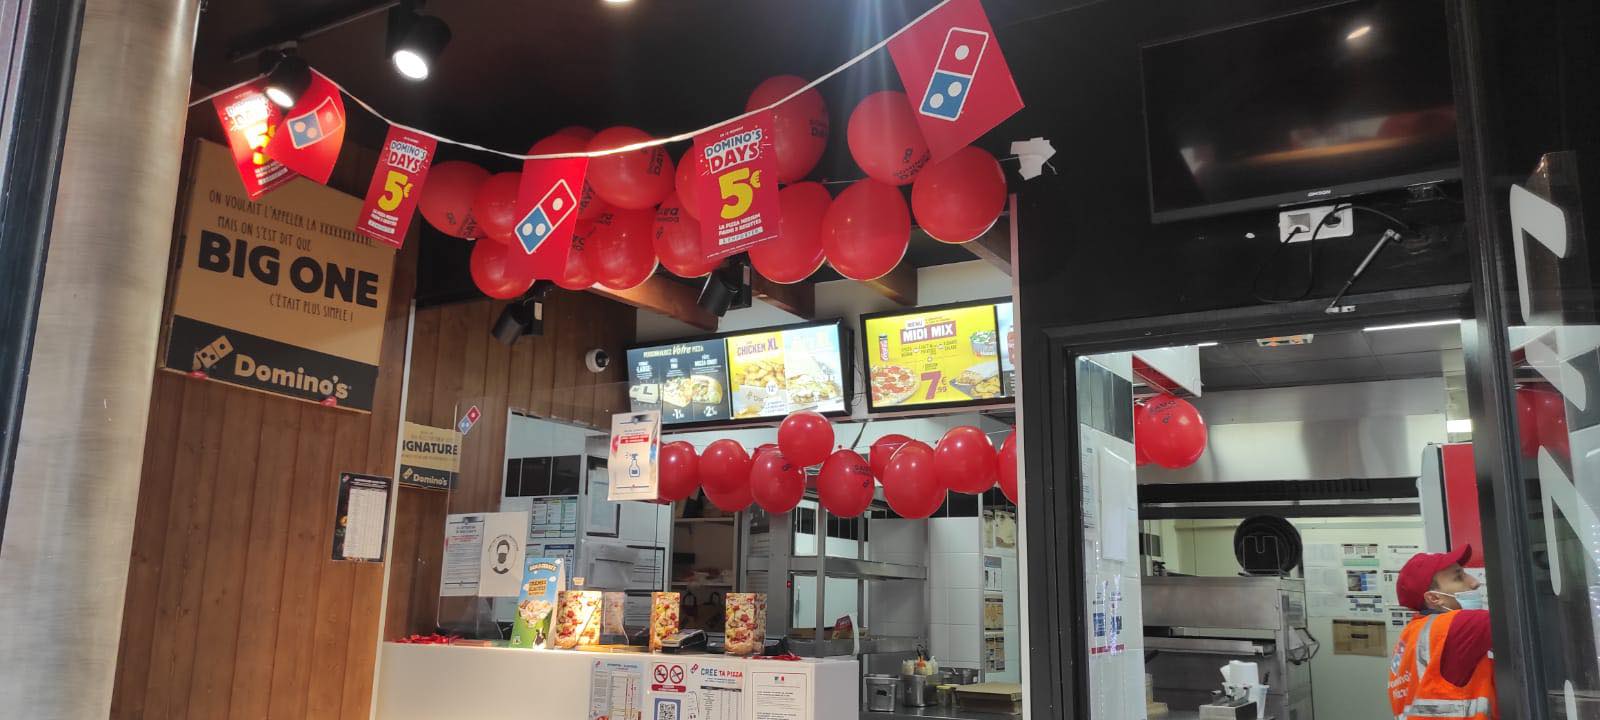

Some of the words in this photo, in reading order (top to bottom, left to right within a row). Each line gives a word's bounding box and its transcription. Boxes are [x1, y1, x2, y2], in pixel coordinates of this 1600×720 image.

[391, 141, 427, 160] DOMINO'S
[706, 129, 762, 158] DOMINO'S
[389, 151, 421, 173] DAYS
[711, 142, 759, 171] DAYS
[208, 189, 221, 203] ON
[225, 194, 262, 216] VOULAIT
[263, 203, 304, 229] L'APPELER
[306, 217, 318, 233] LA
[217, 215, 238, 234] MAIS
[241, 222, 253, 237] ON
[255, 224, 277, 242] S'EST
[279, 231, 294, 246] DIT
[296, 236, 312, 252] QUE
[198, 229, 281, 286] BIG
[289, 256, 379, 308] ONE
[303, 300, 321, 316] PLUS
[323, 304, 348, 322] SIMPLE
[902, 328, 928, 343] MIDI
[930, 323, 953, 338] MIX
[737, 343, 766, 357] CHICKEN
[767, 337, 779, 351] XL
[234, 353, 349, 400] Domino's
[413, 473, 448, 486] Domino's
[719, 670, 726, 678] TA
[726, 671, 743, 679] PIZZA
